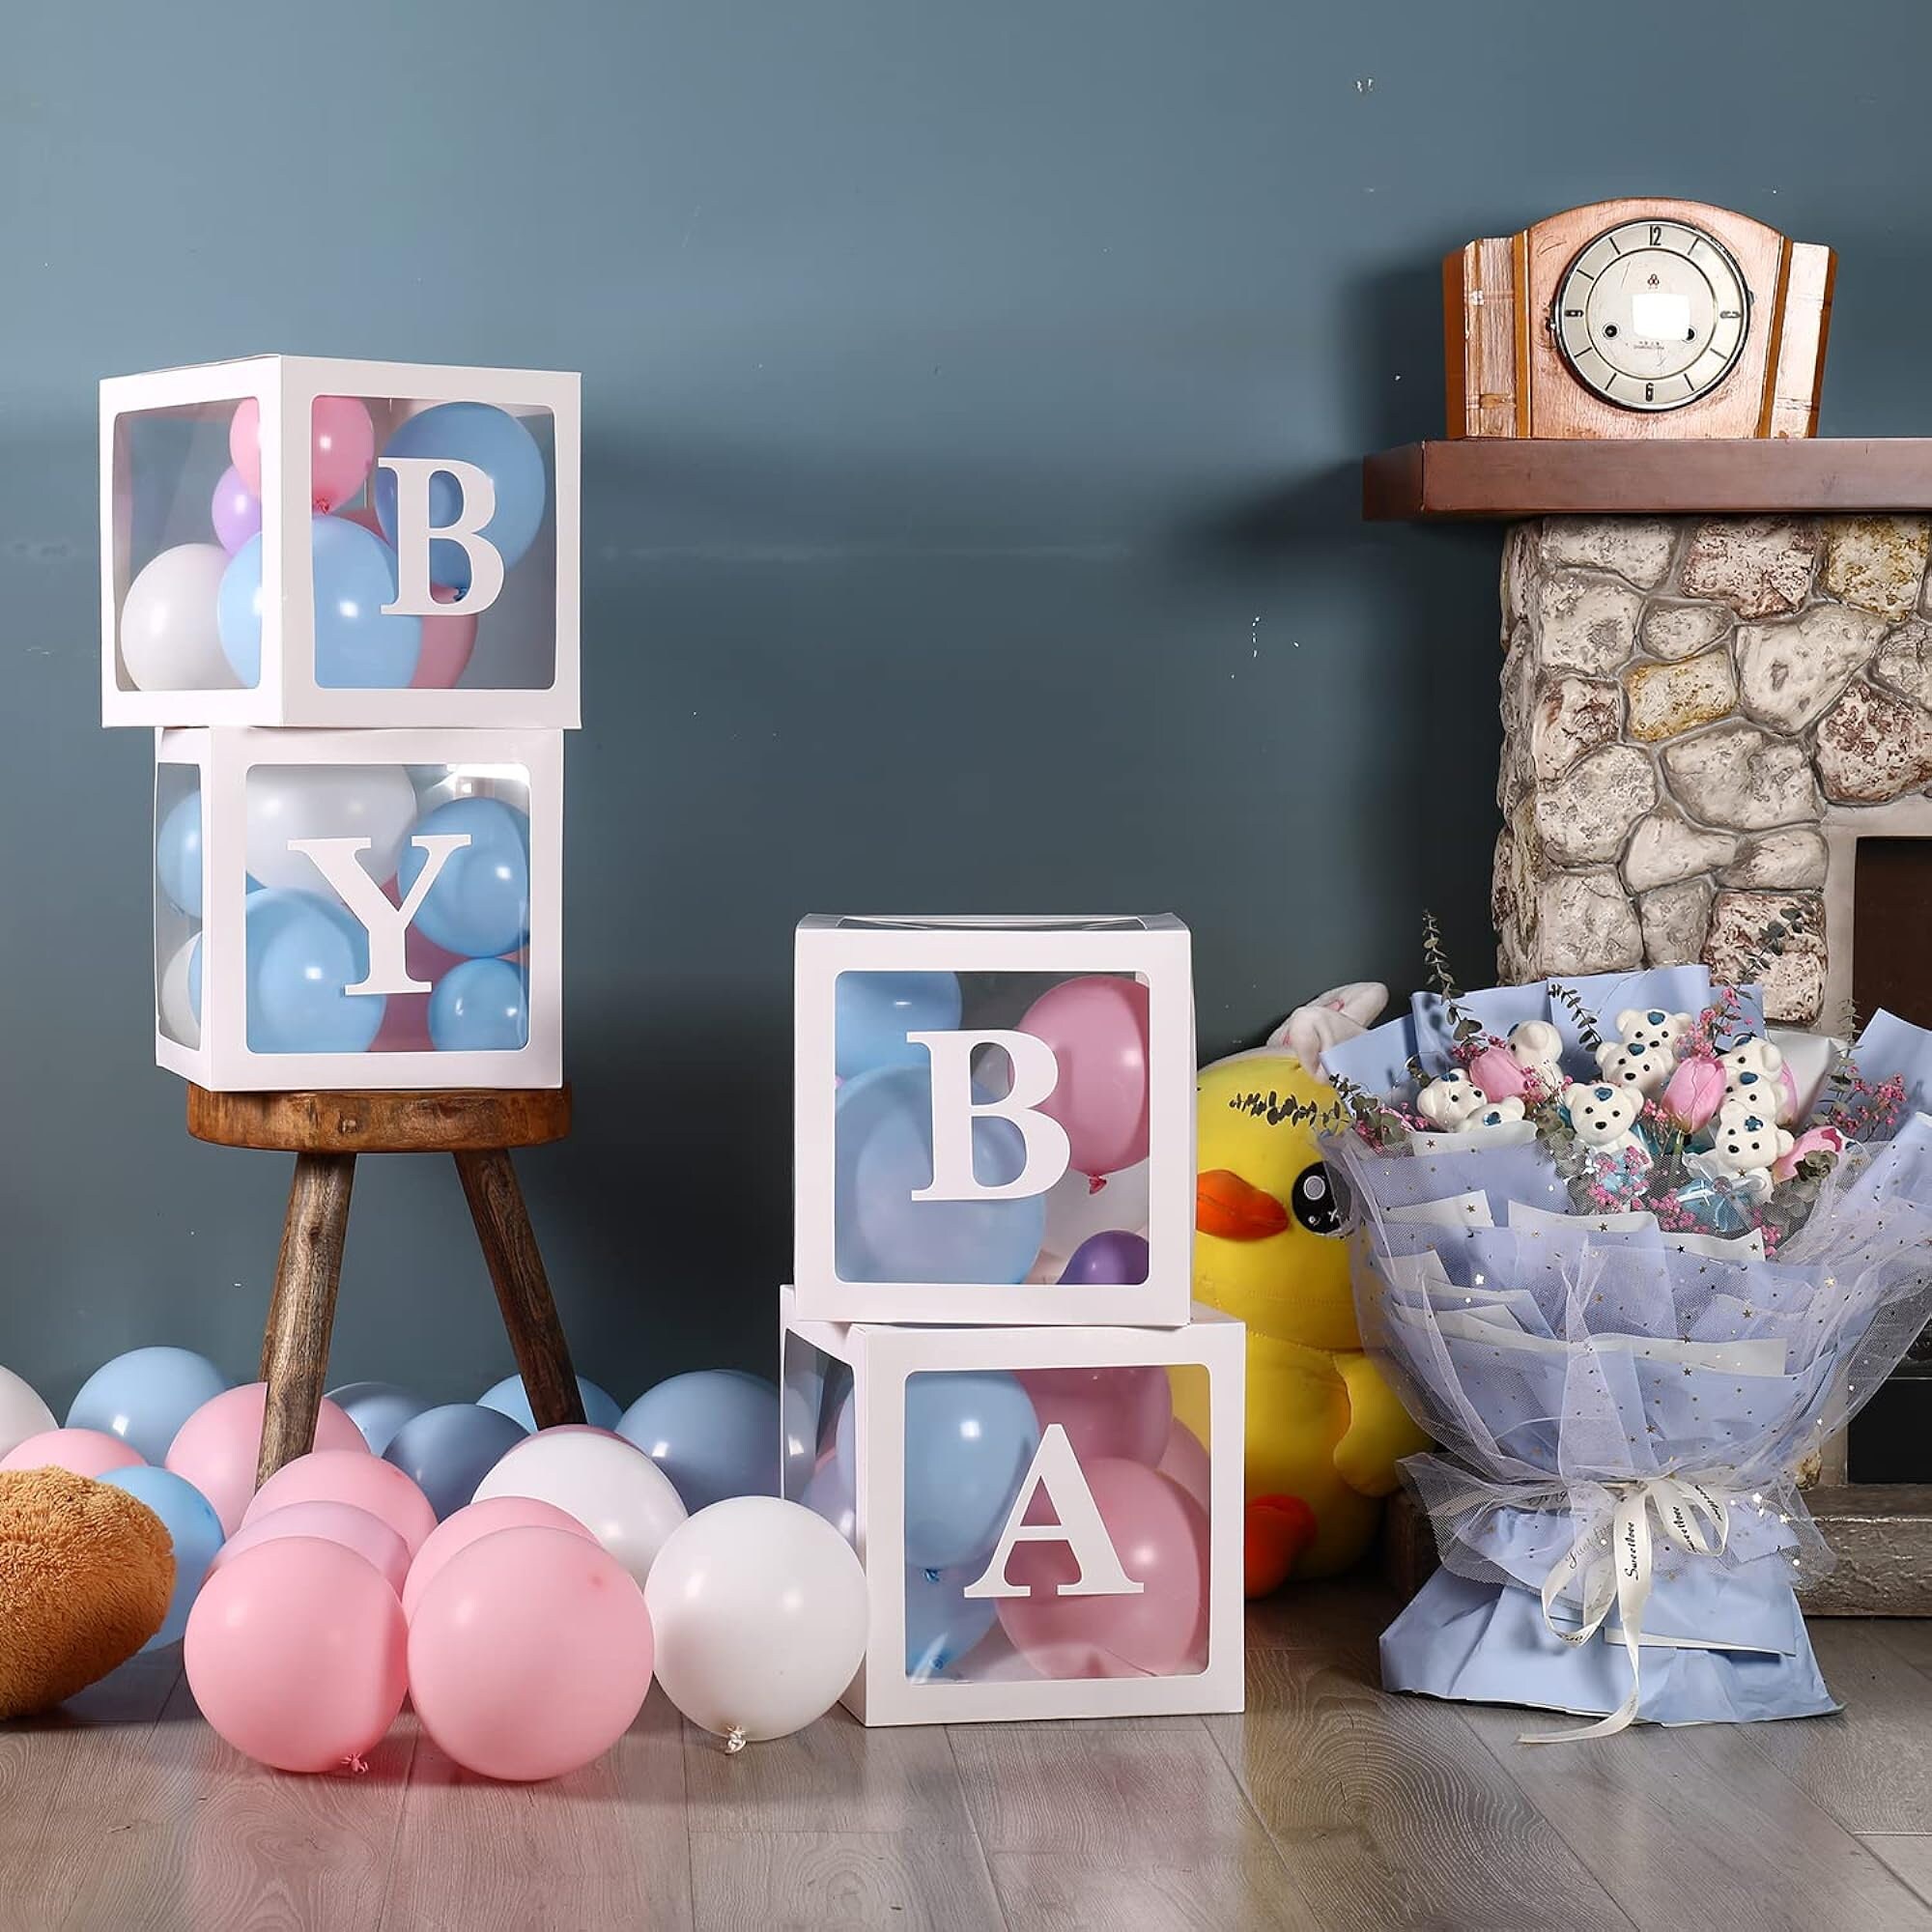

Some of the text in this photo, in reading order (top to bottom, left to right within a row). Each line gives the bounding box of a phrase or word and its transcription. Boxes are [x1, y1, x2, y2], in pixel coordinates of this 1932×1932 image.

[1649, 225, 1662, 246] 12
[1645, 382, 1655, 402] 6
[378, 457, 505, 616] B
[287, 835, 471, 997] Y
[906, 1029, 1070, 1202] B
[964, 1424, 1144, 1599] A
